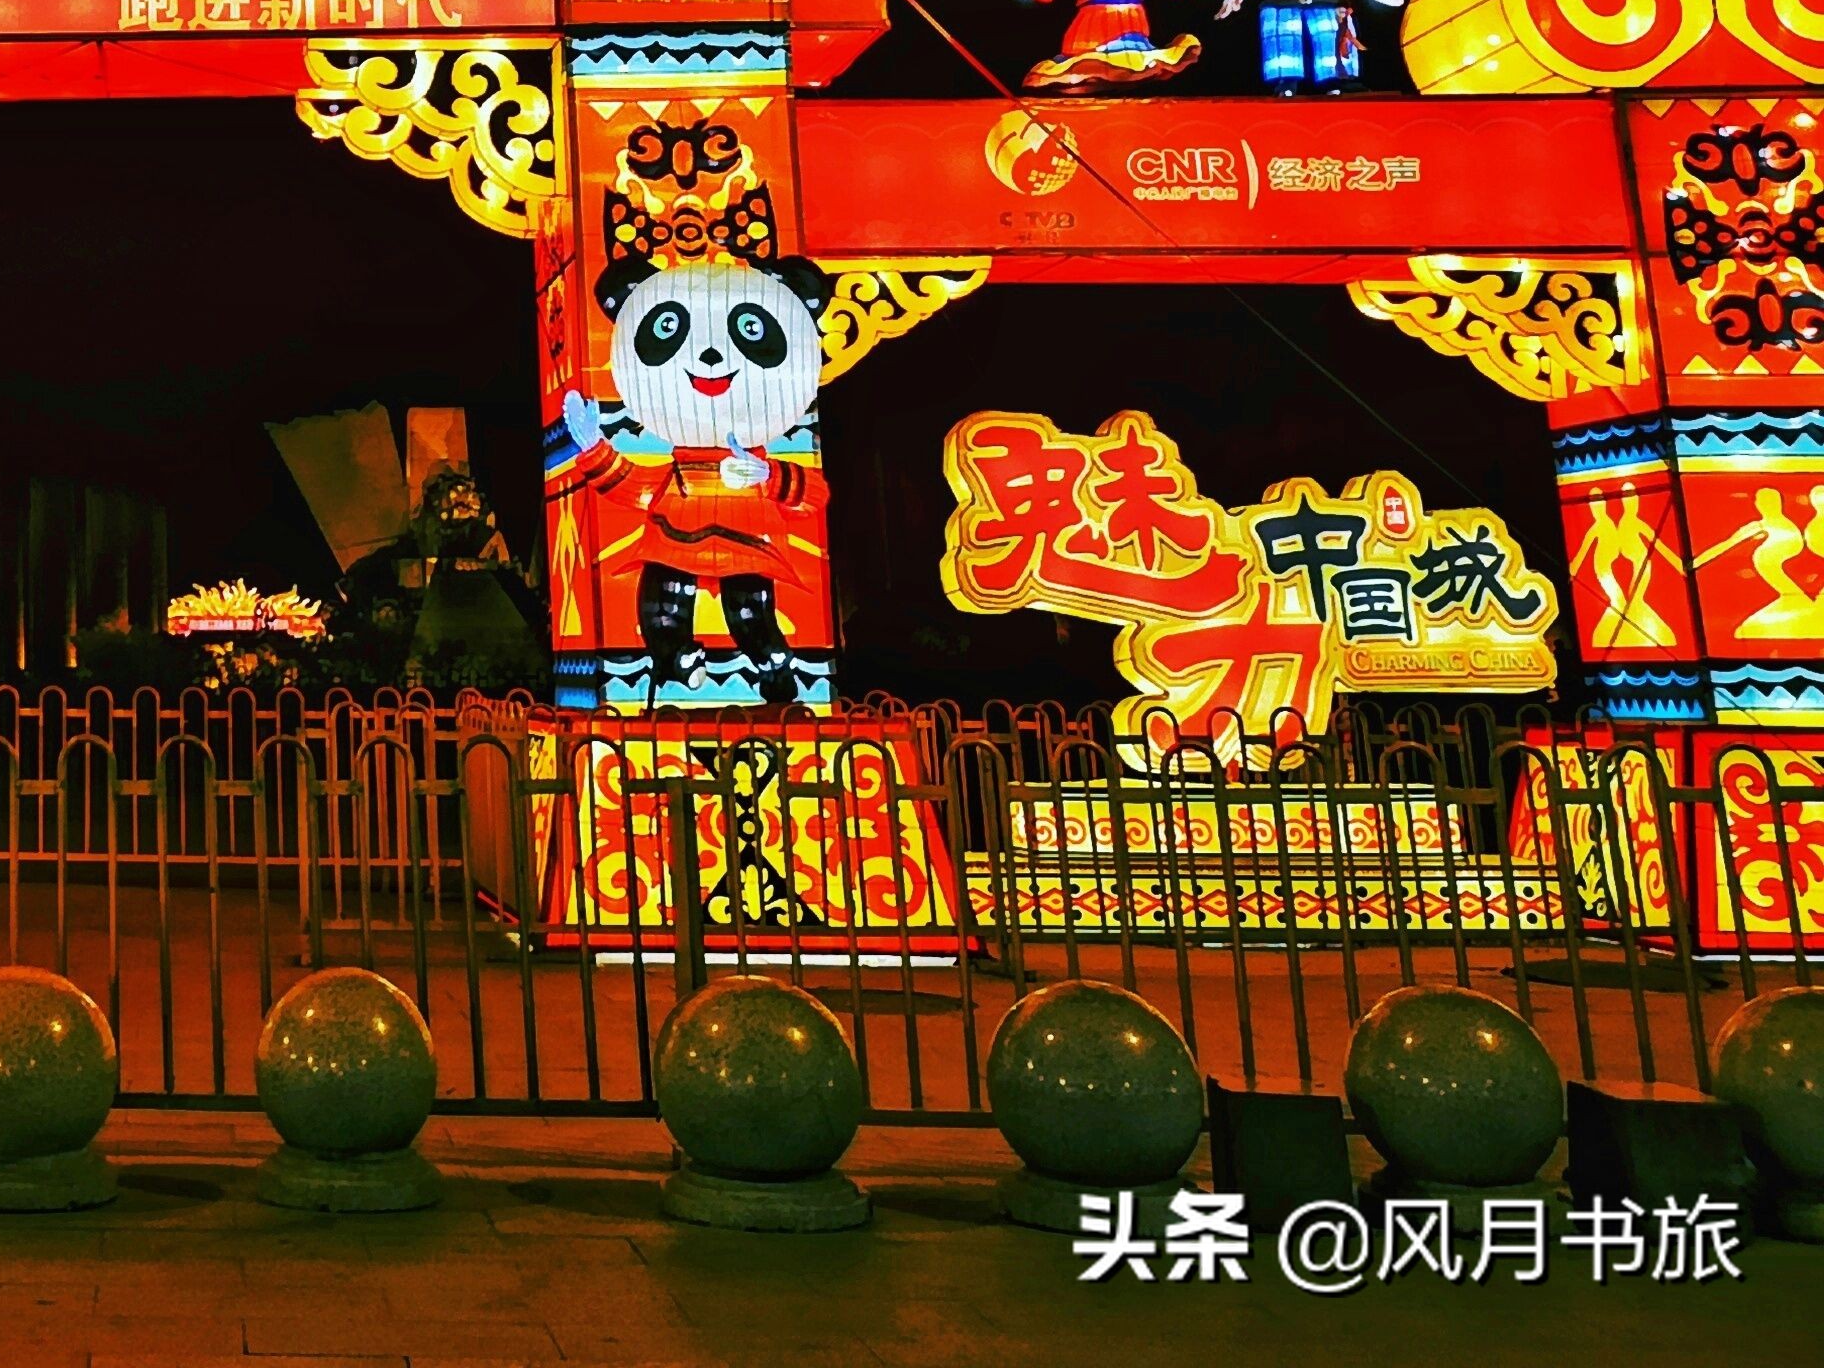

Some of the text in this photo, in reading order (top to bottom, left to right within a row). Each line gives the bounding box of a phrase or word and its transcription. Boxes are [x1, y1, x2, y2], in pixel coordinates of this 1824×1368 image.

[1126, 147, 1238, 184] CNR
[1267, 156, 1422, 192] 经济之声
